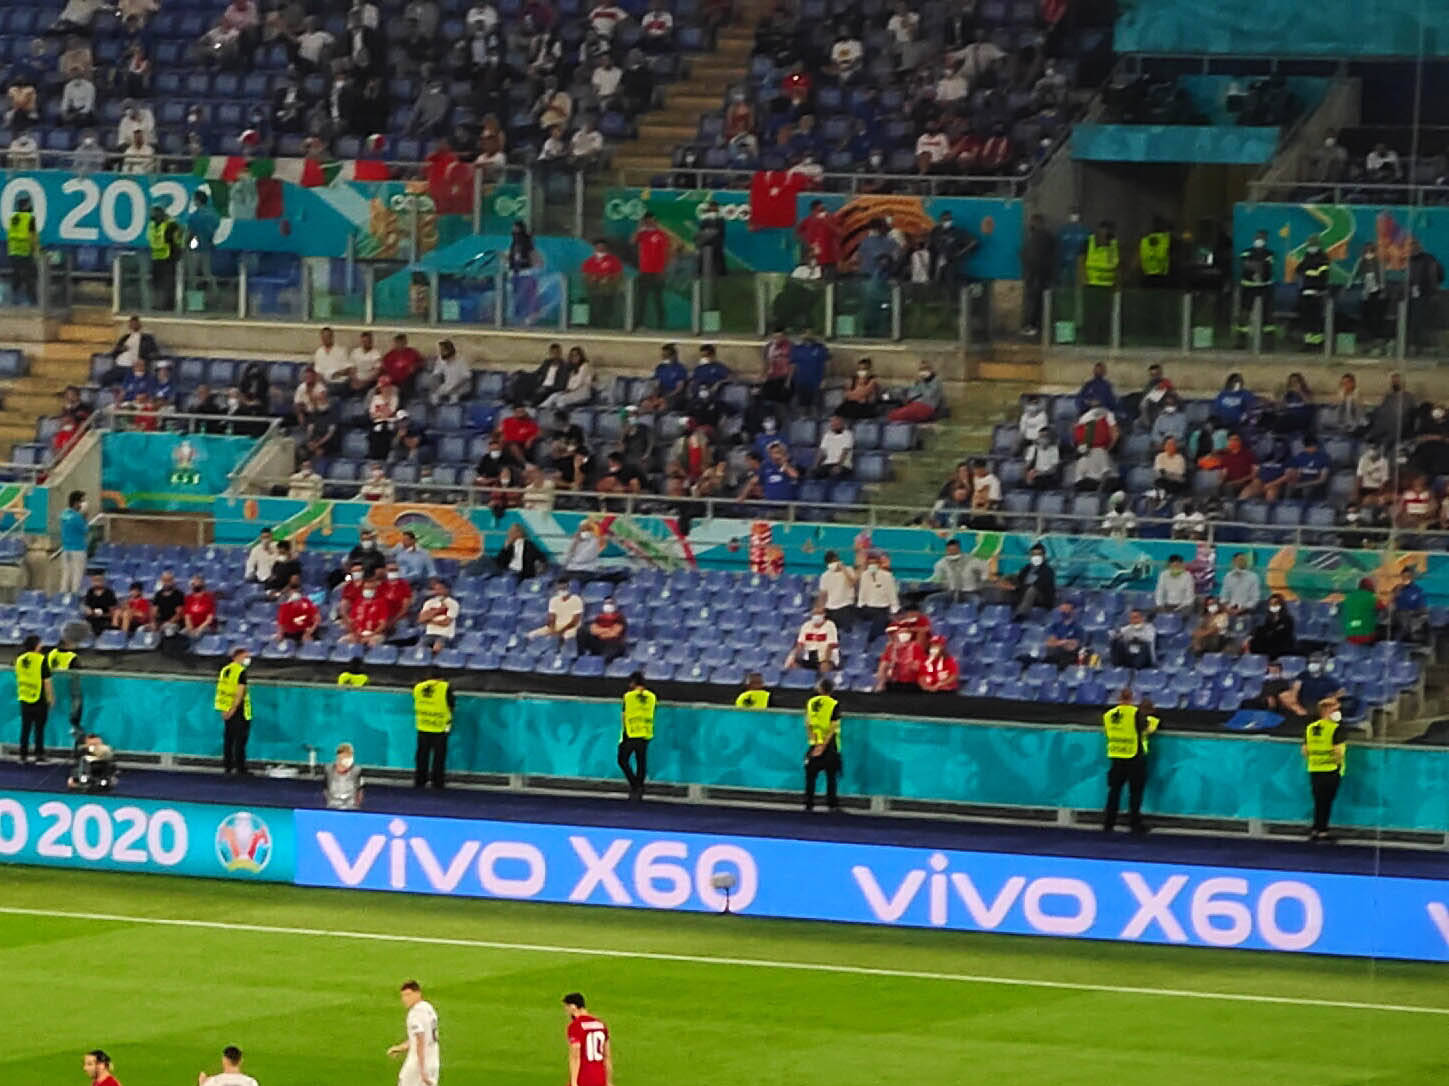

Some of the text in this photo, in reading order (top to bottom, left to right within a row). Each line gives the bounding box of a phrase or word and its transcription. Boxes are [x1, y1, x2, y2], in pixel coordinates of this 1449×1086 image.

[59, 177, 233, 245] 202
[37, 802, 188, 865] 2020
[316, 818, 758, 914] vivo X60
[852, 853, 1323, 951] vivo X60
[586, 1031, 606, 1061] 10
